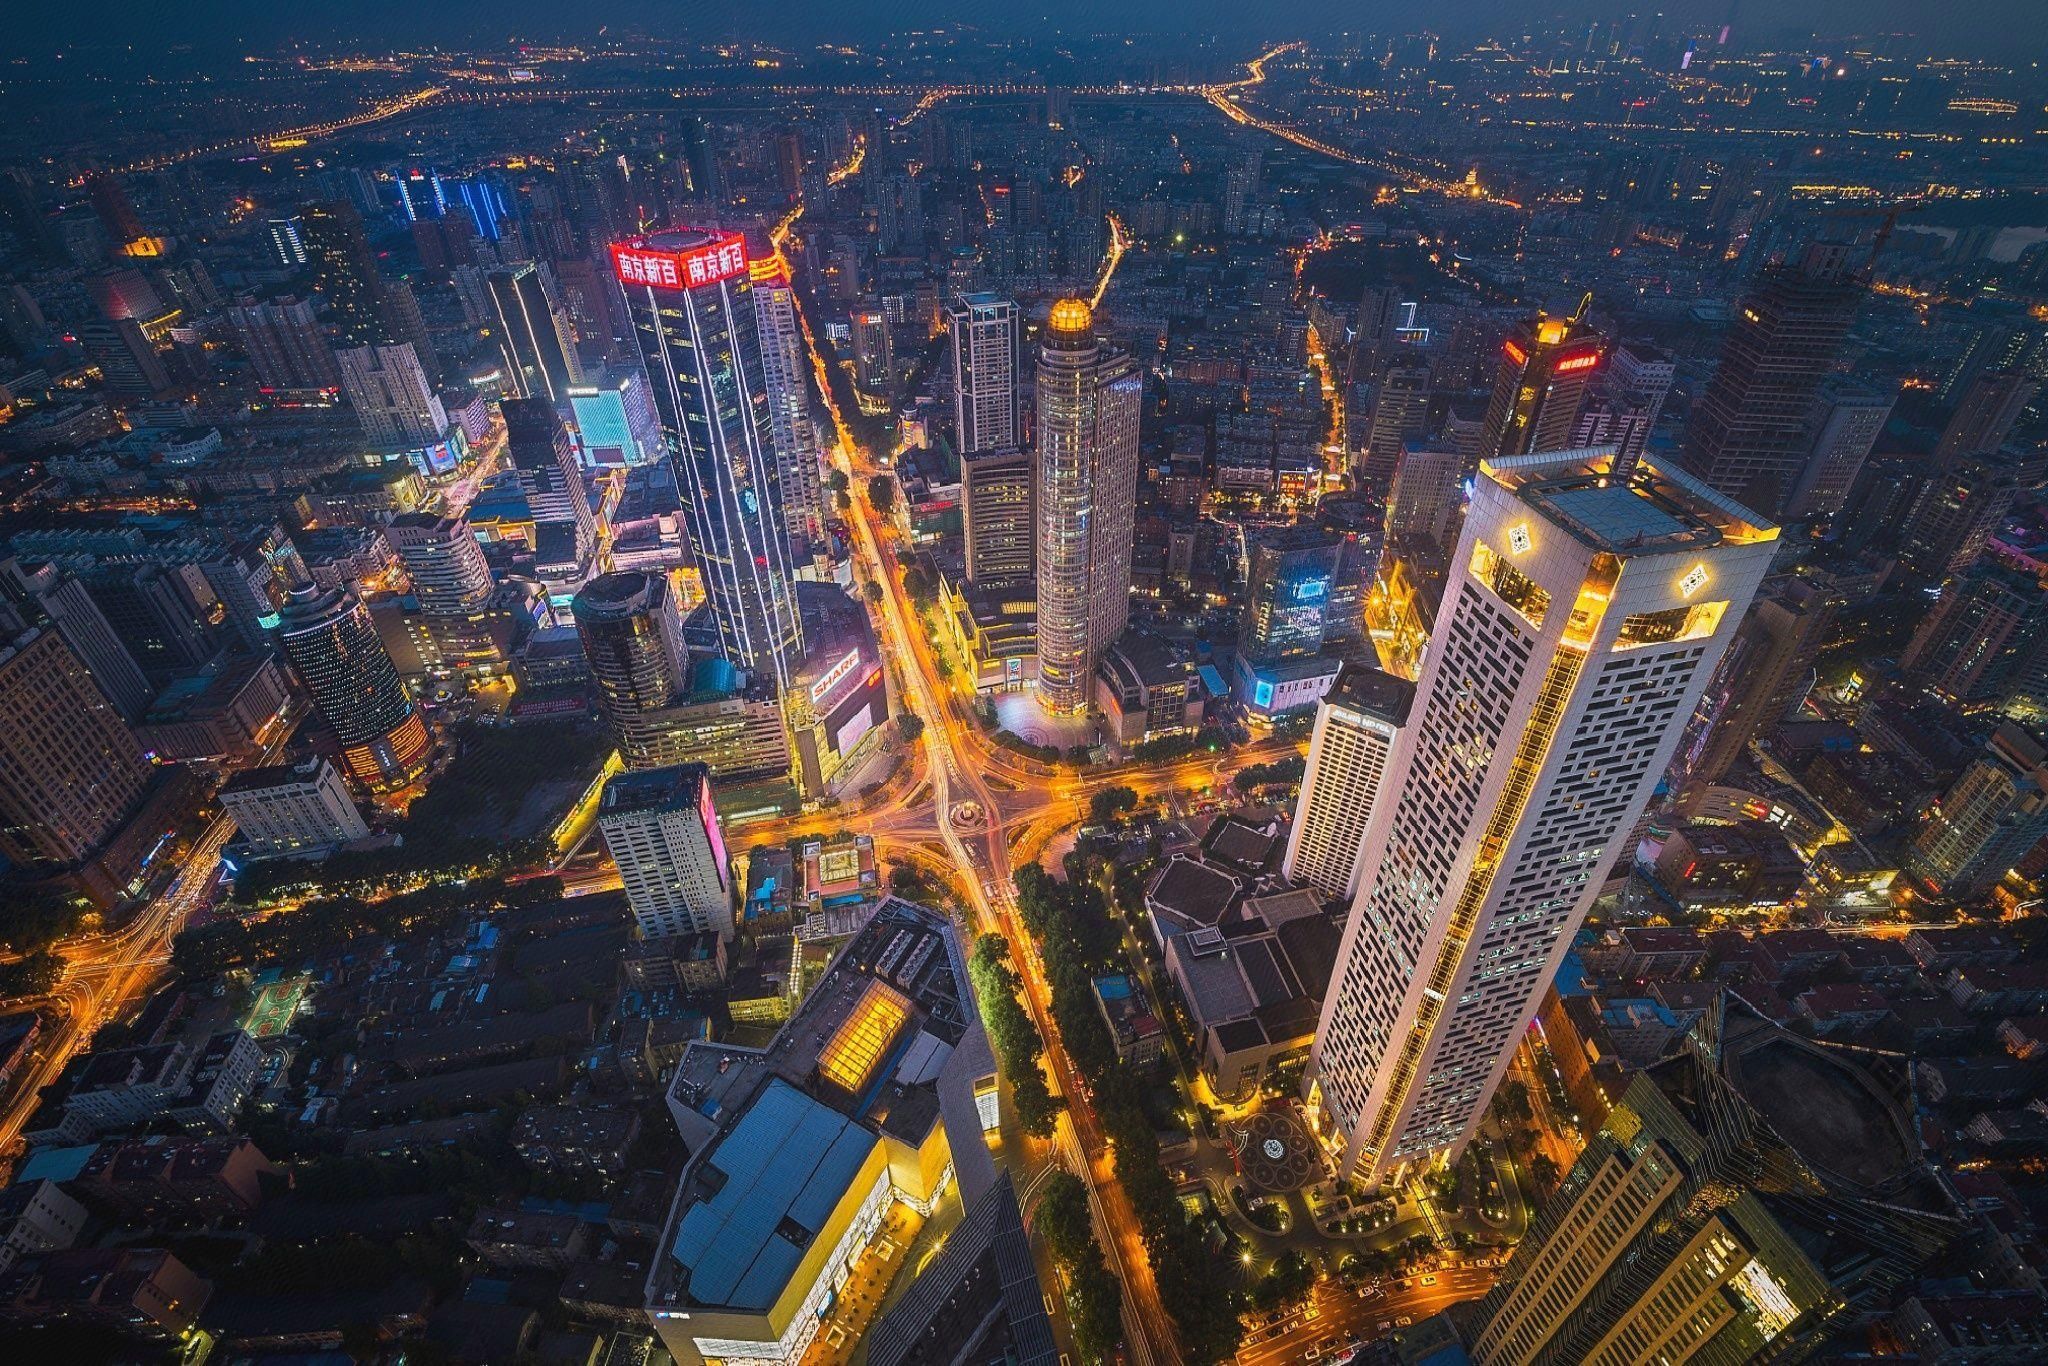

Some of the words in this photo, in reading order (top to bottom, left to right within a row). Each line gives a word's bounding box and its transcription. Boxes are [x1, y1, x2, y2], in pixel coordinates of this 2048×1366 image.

[617, 252, 678, 285] 南京新百
[687, 242, 744, 284] 南京新百
[813, 653, 858, 698] SHARP
